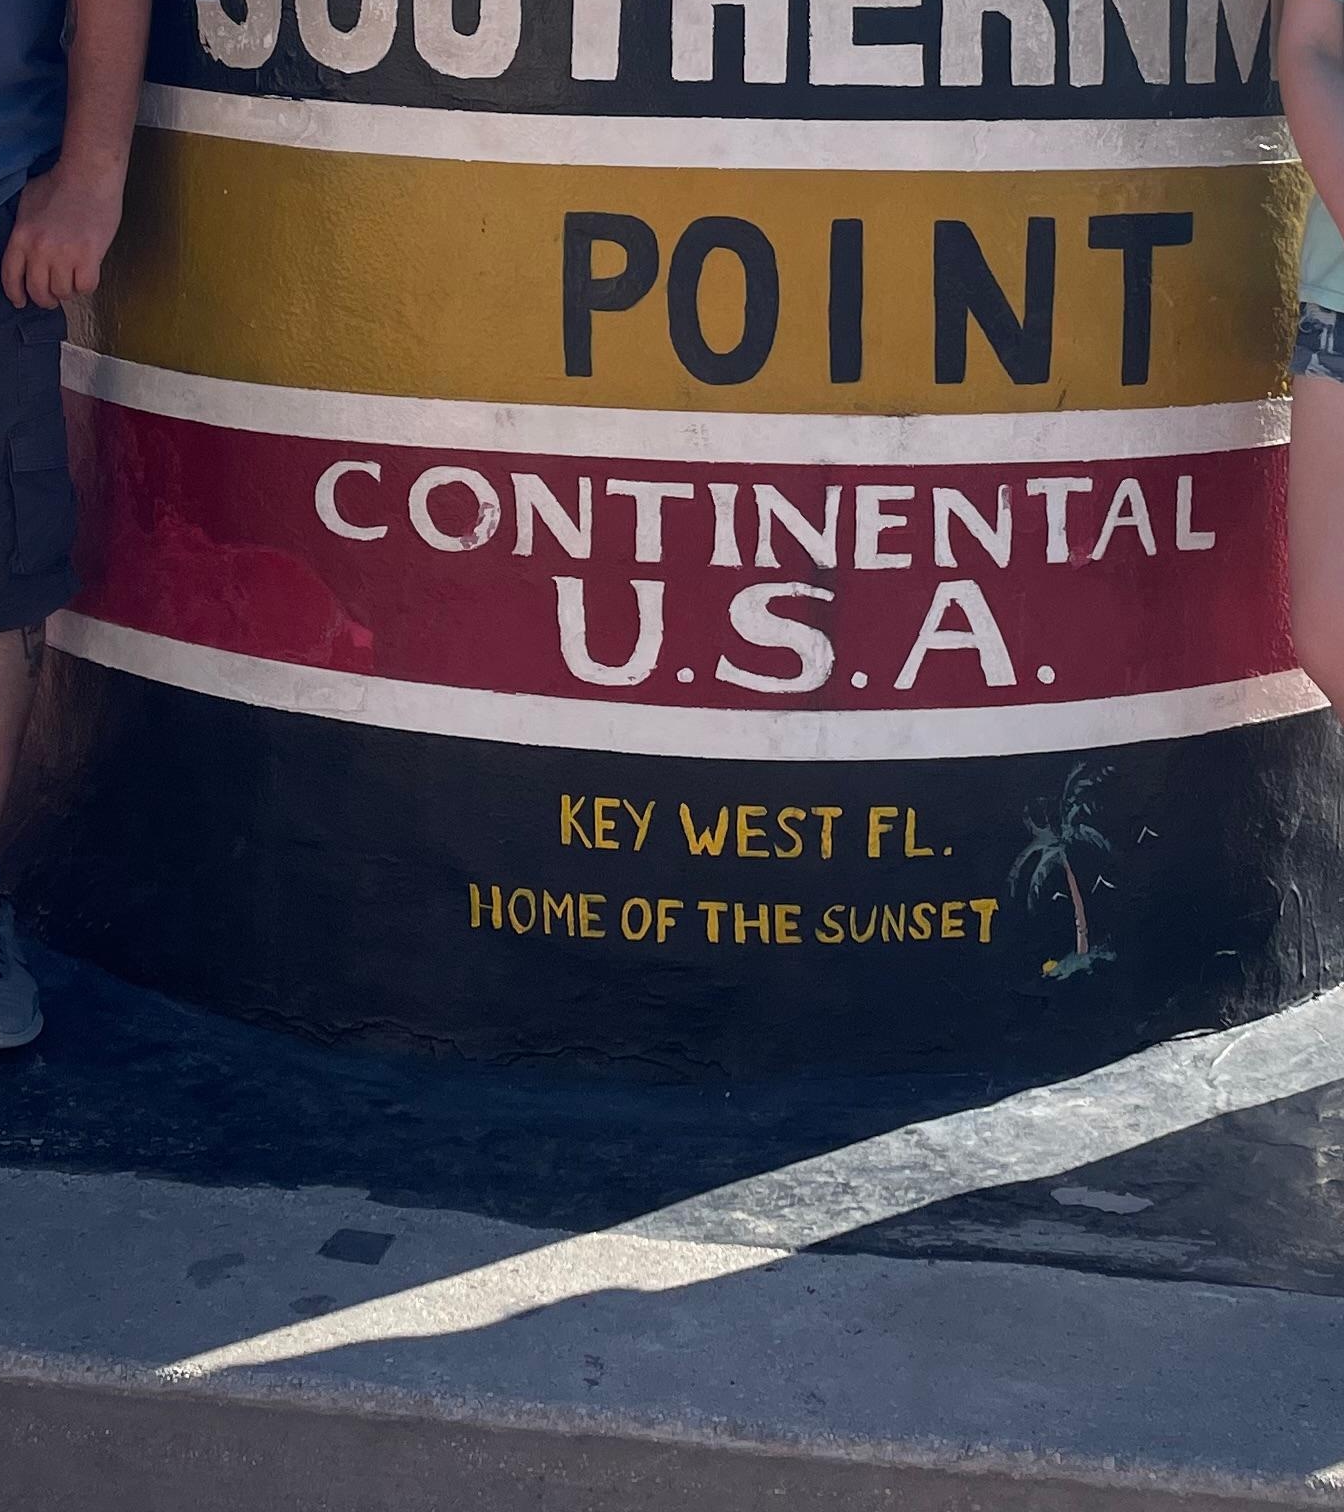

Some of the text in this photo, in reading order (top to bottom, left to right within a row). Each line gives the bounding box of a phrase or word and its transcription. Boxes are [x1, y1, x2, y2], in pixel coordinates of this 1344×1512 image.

[561, 210, 1194, 387] POINT
[313, 459, 1216, 571] CONTINENTAL
[551, 574, 1057, 694] U.S.A.
[559, 793, 955, 861] KEY WEST FL.
[467, 883, 1000, 945] HOME OF THE SUNSET
